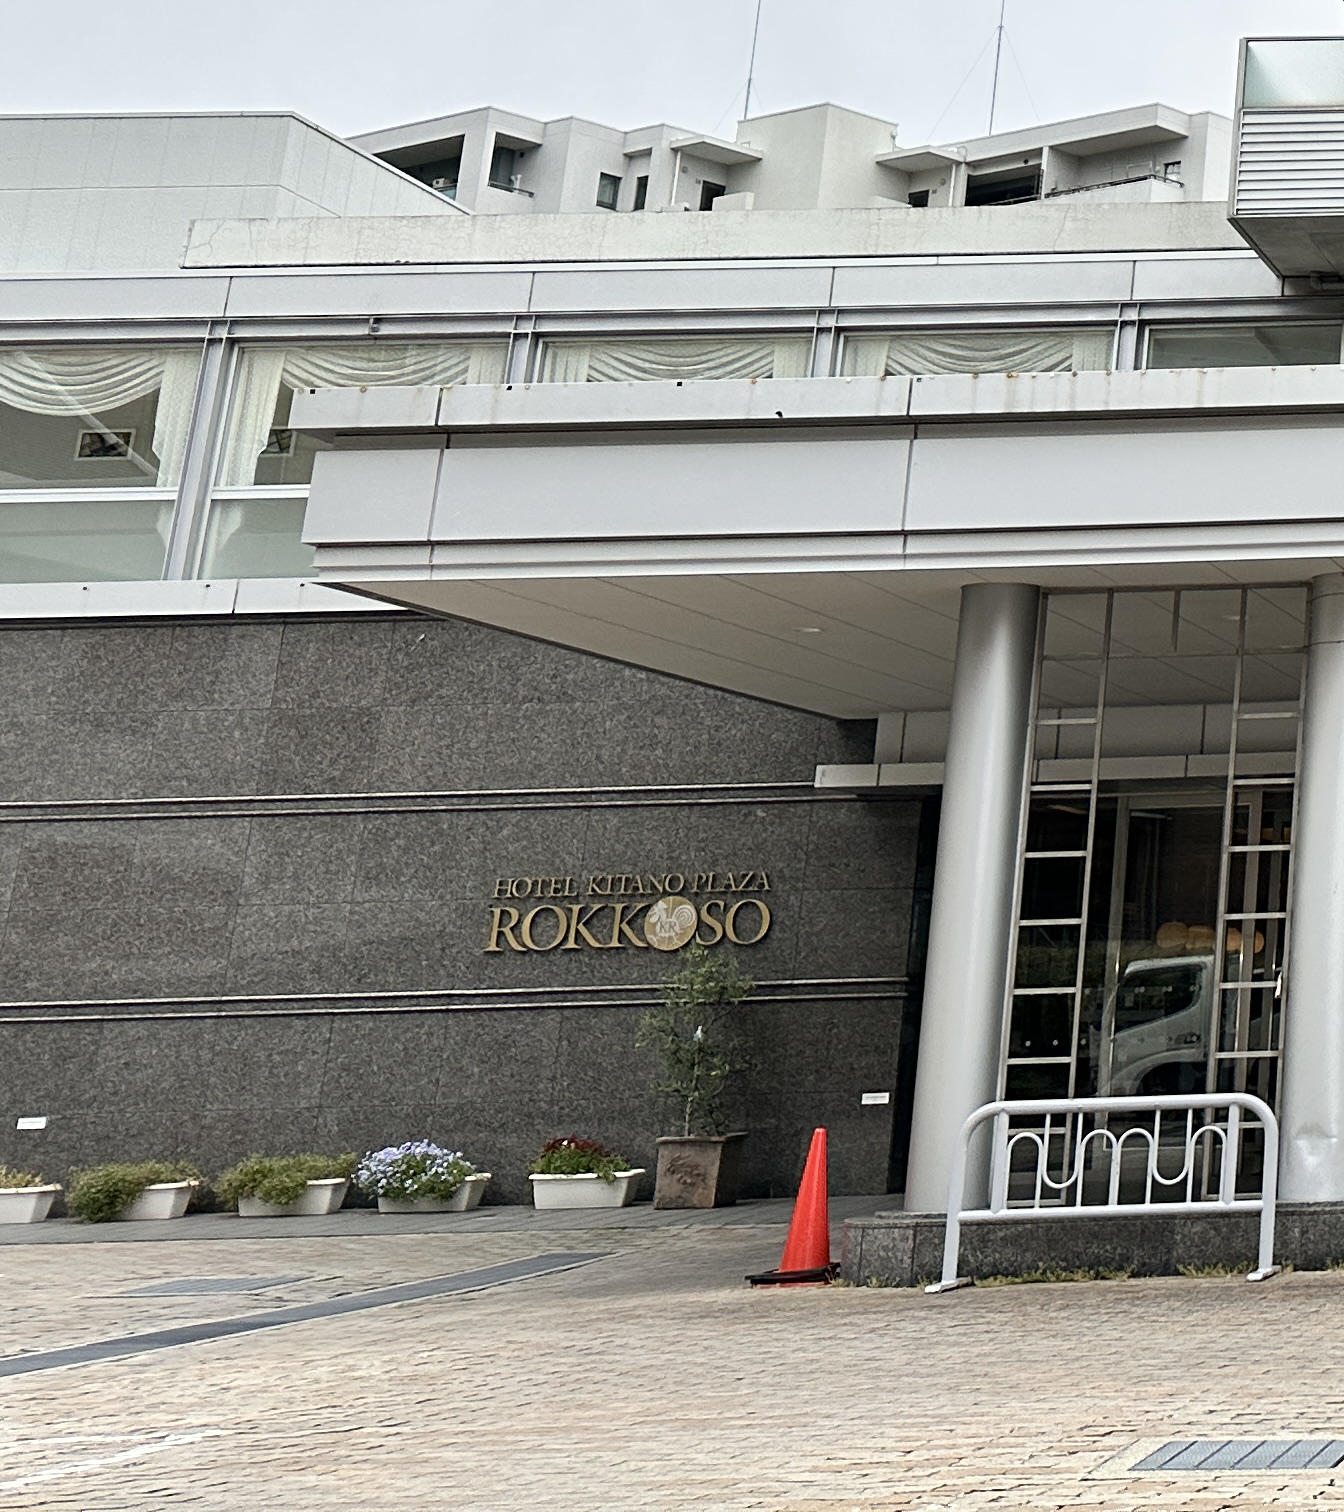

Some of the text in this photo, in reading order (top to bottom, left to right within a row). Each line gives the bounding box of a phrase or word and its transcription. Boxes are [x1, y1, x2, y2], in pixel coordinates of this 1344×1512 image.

[492, 871, 771, 899] HOTEL KITANO PLAZA
